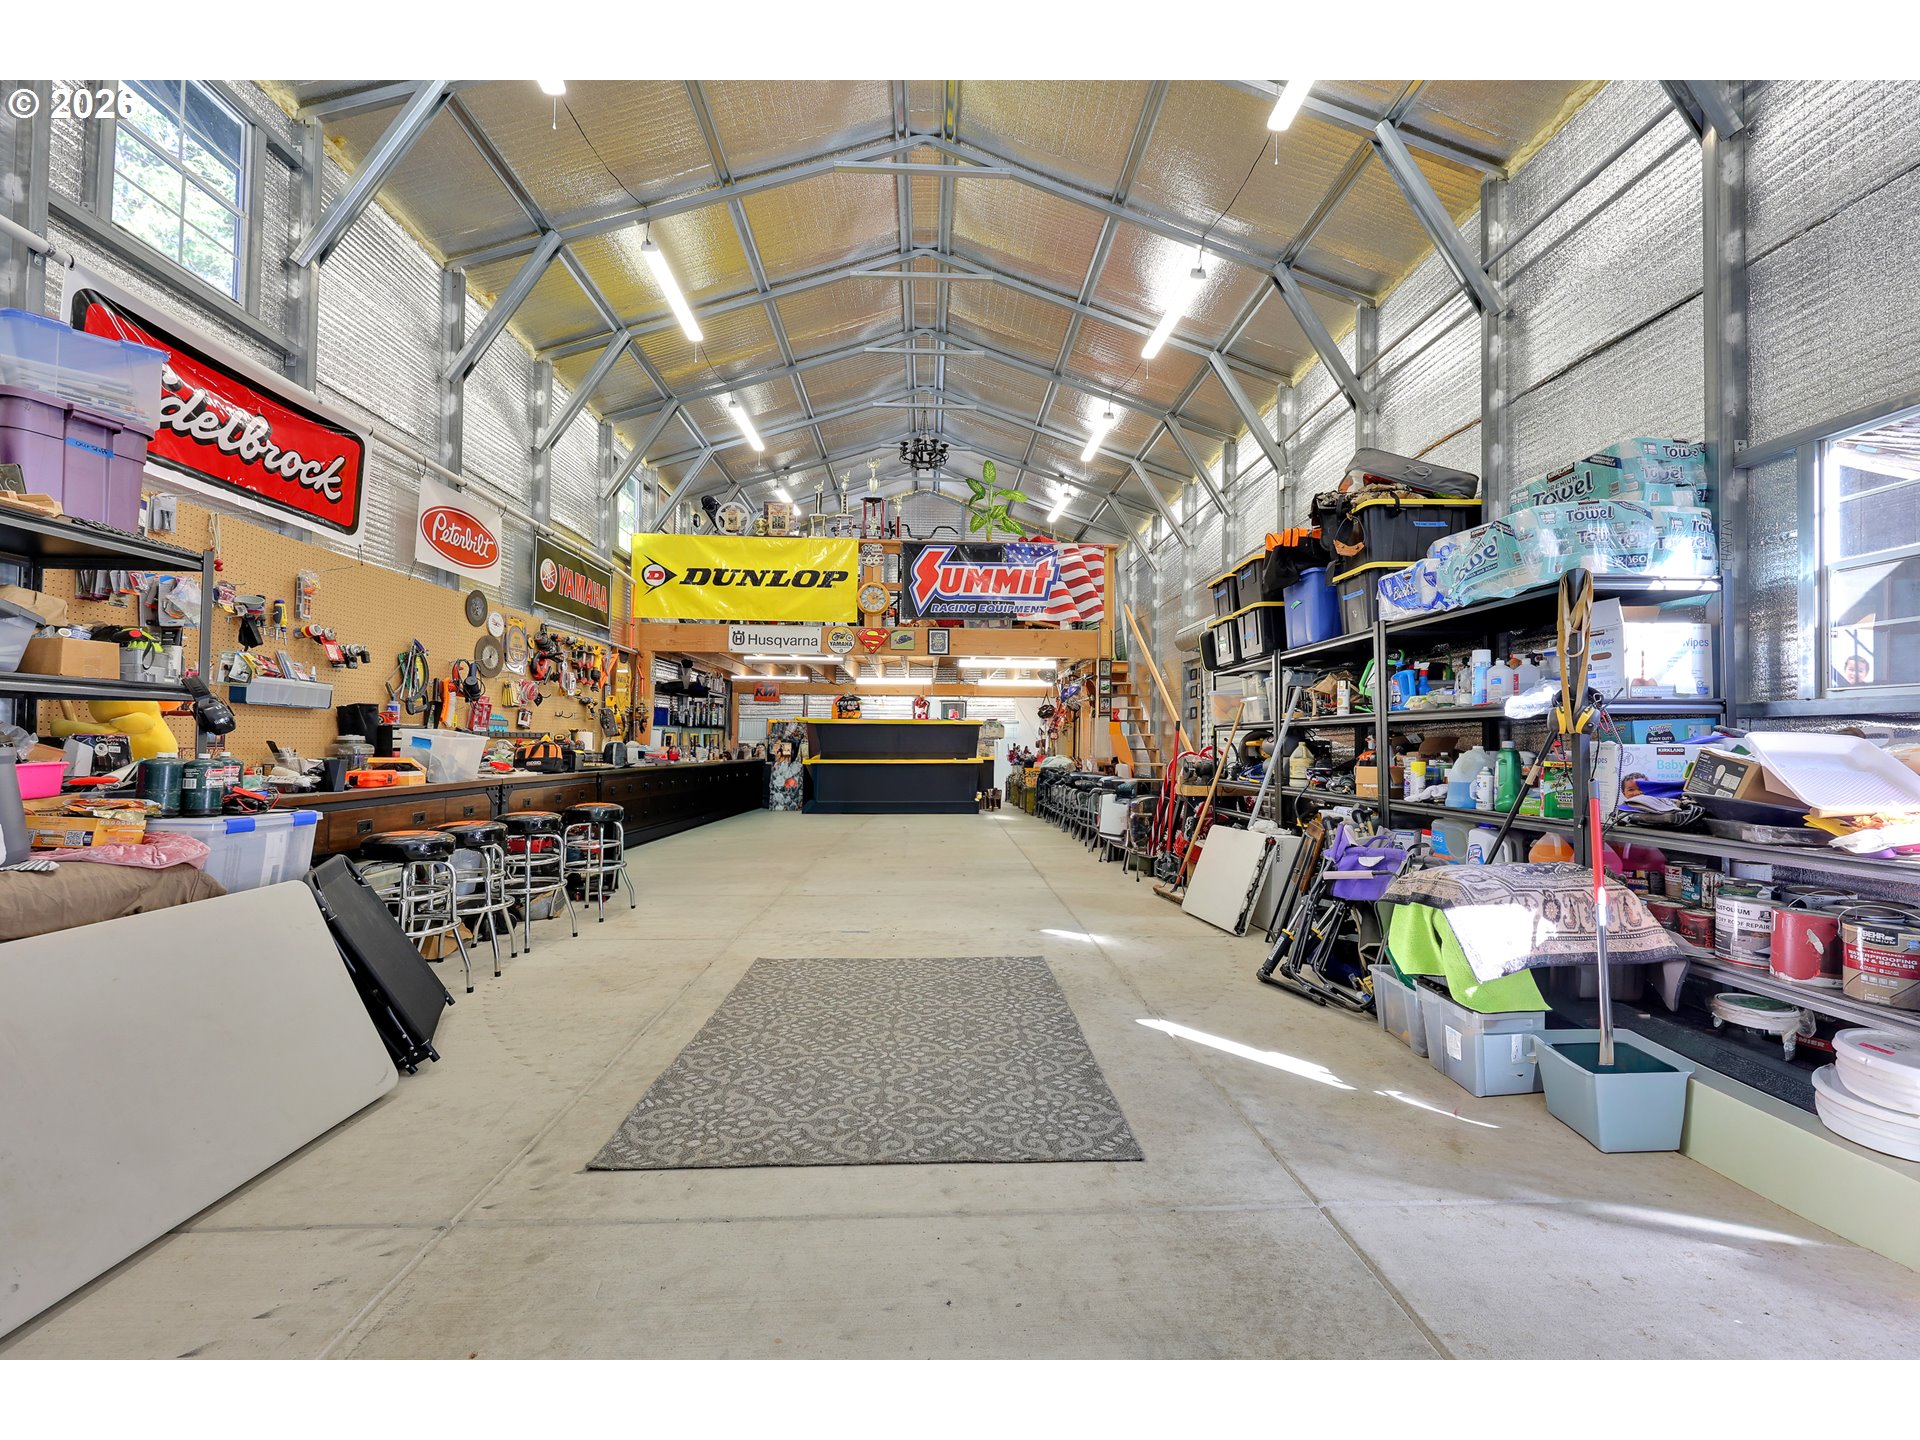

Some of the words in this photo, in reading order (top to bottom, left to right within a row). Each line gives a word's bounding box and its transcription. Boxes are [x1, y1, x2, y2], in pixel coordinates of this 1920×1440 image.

[160, 363, 343, 502] delbrock
[1532, 469, 1594, 505] Towel
[1565, 506, 1615, 522] Towel
[432, 512, 494, 559] Peterbilt
[866, 554, 880, 565] 66
[679, 567, 849, 588] DUNLOP
[558, 563, 608, 614] YAMAHA
[931, 604, 976, 613] RACING
[978, 604, 1047, 614] EQUIPMENT
[747, 633, 819, 648] Husqvarna
[755, 687, 777, 697] KTM
[1657, 759, 1684, 773] Baby
[1746, 921, 1771, 930] REPAIR
[1862, 930, 1885, 939] BEHR
[1848, 949, 1918, 965] WATRPROOFING
[1879, 960, 1915, 969] SEALER
